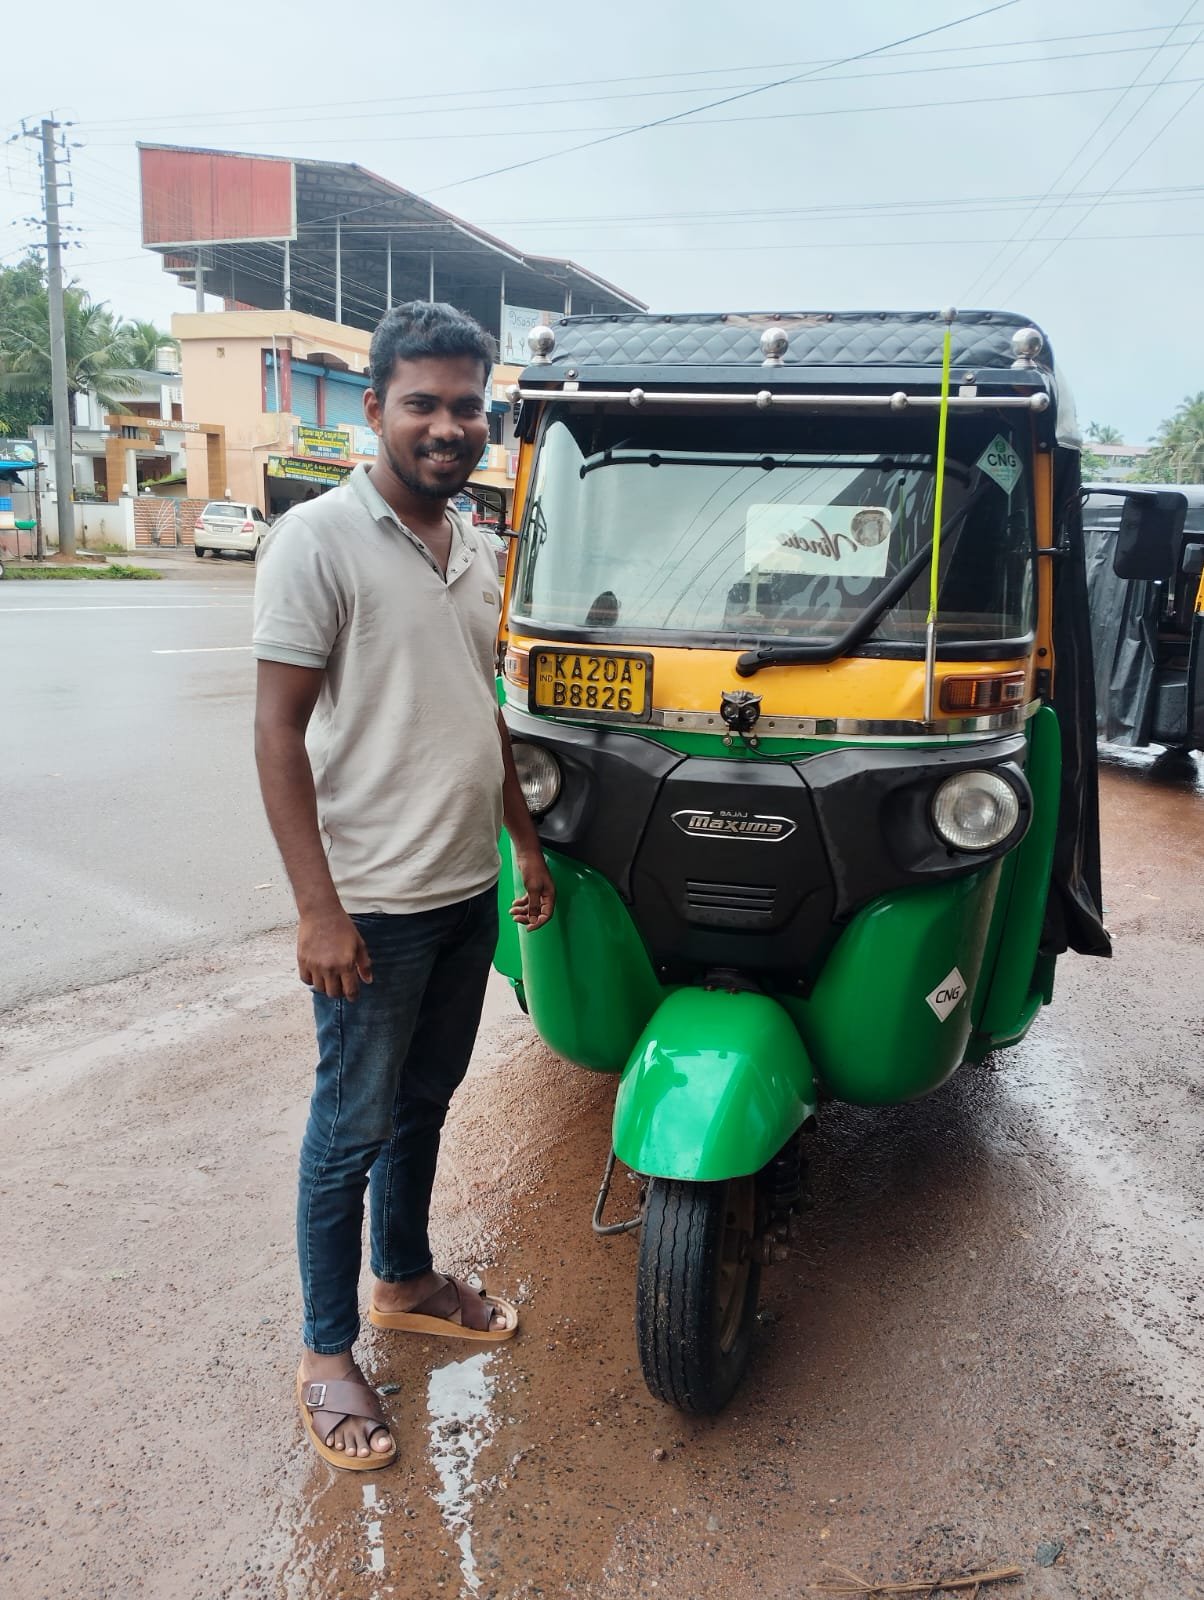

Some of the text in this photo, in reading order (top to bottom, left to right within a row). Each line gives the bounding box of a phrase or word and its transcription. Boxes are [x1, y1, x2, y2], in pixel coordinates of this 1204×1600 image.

[987, 453, 1017, 467] CNG
[554, 654, 632, 684] KA20A
[539, 674, 553, 682] IND
[553, 681, 633, 711] B8826
[720, 810, 748, 818] BAJAJ
[936, 985, 961, 1004] CNG
